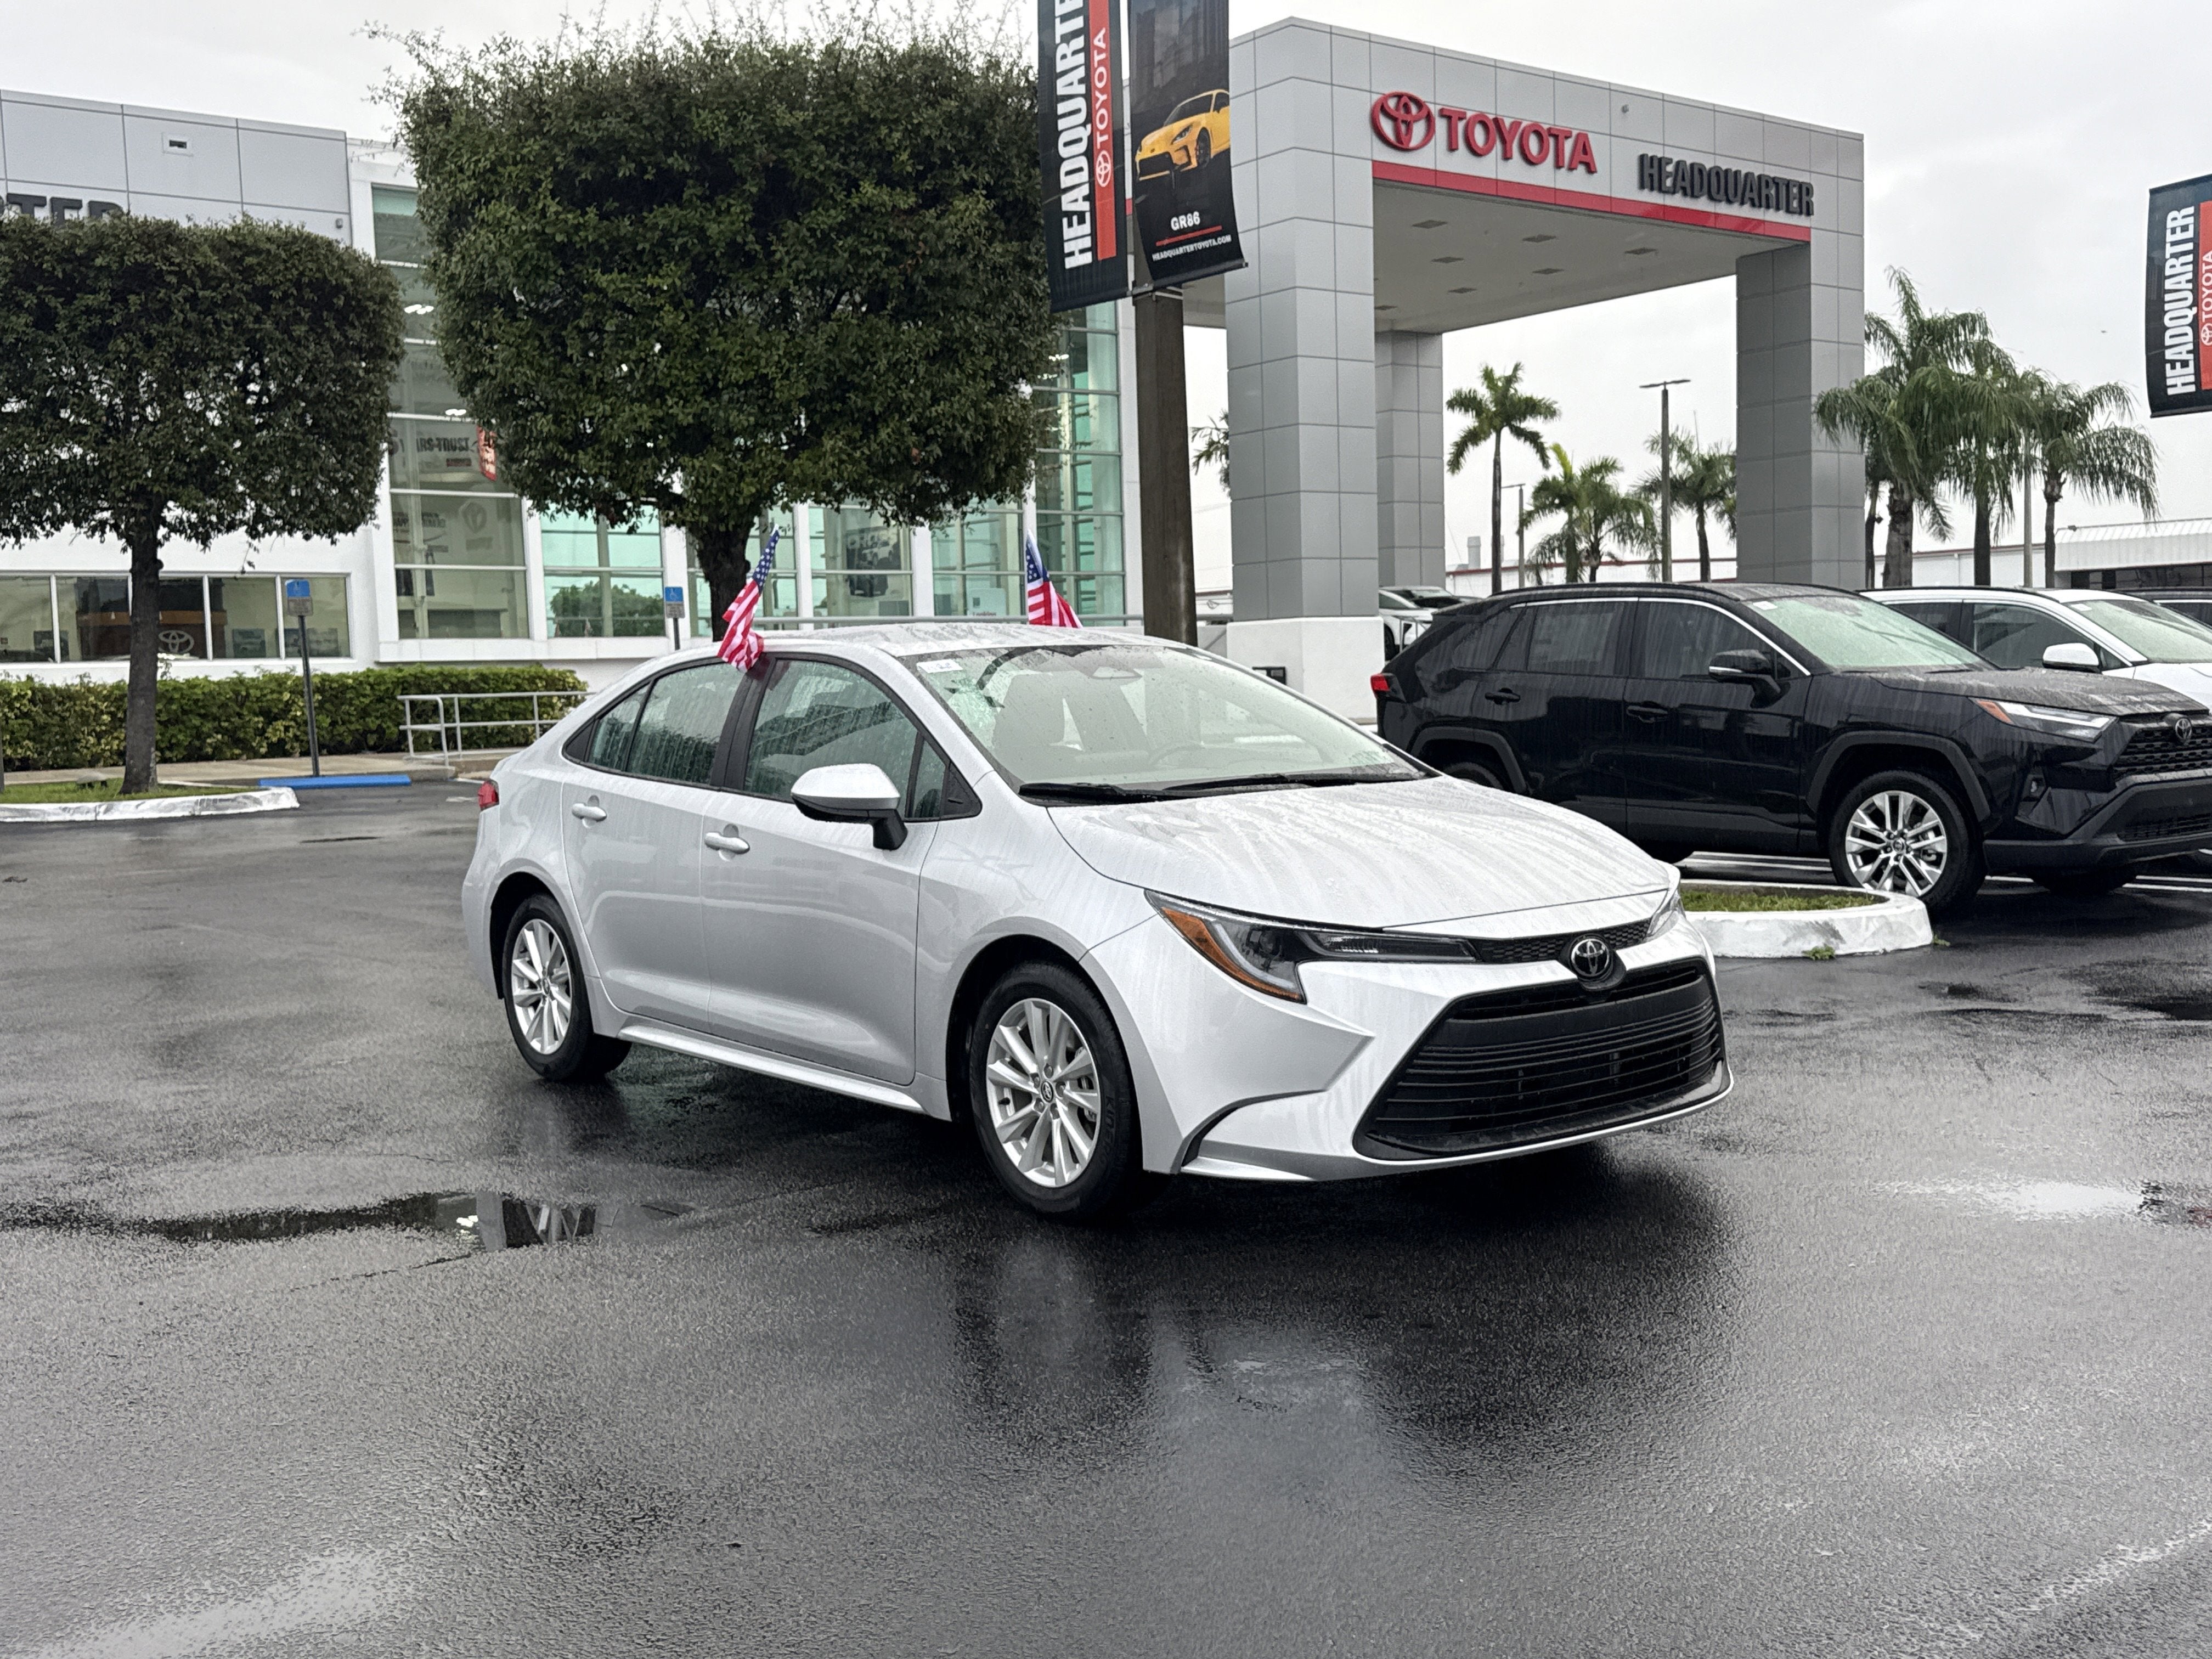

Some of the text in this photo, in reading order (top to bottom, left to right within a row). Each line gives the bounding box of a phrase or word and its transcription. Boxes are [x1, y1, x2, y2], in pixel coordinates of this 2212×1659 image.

[1093, 27, 1110, 150] TOYOTA
[1439, 107, 1598, 174] TOYOTA
[1638, 153, 1815, 216] HEADQUARTER
[1152, 234, 1232, 261] HEADQUARTERTOYOTA.COM
[1170, 211, 1201, 231] GR86
[2164, 206, 2197, 396] HEADQUARTER
[2202, 250, 2212, 323] TOYOTA
